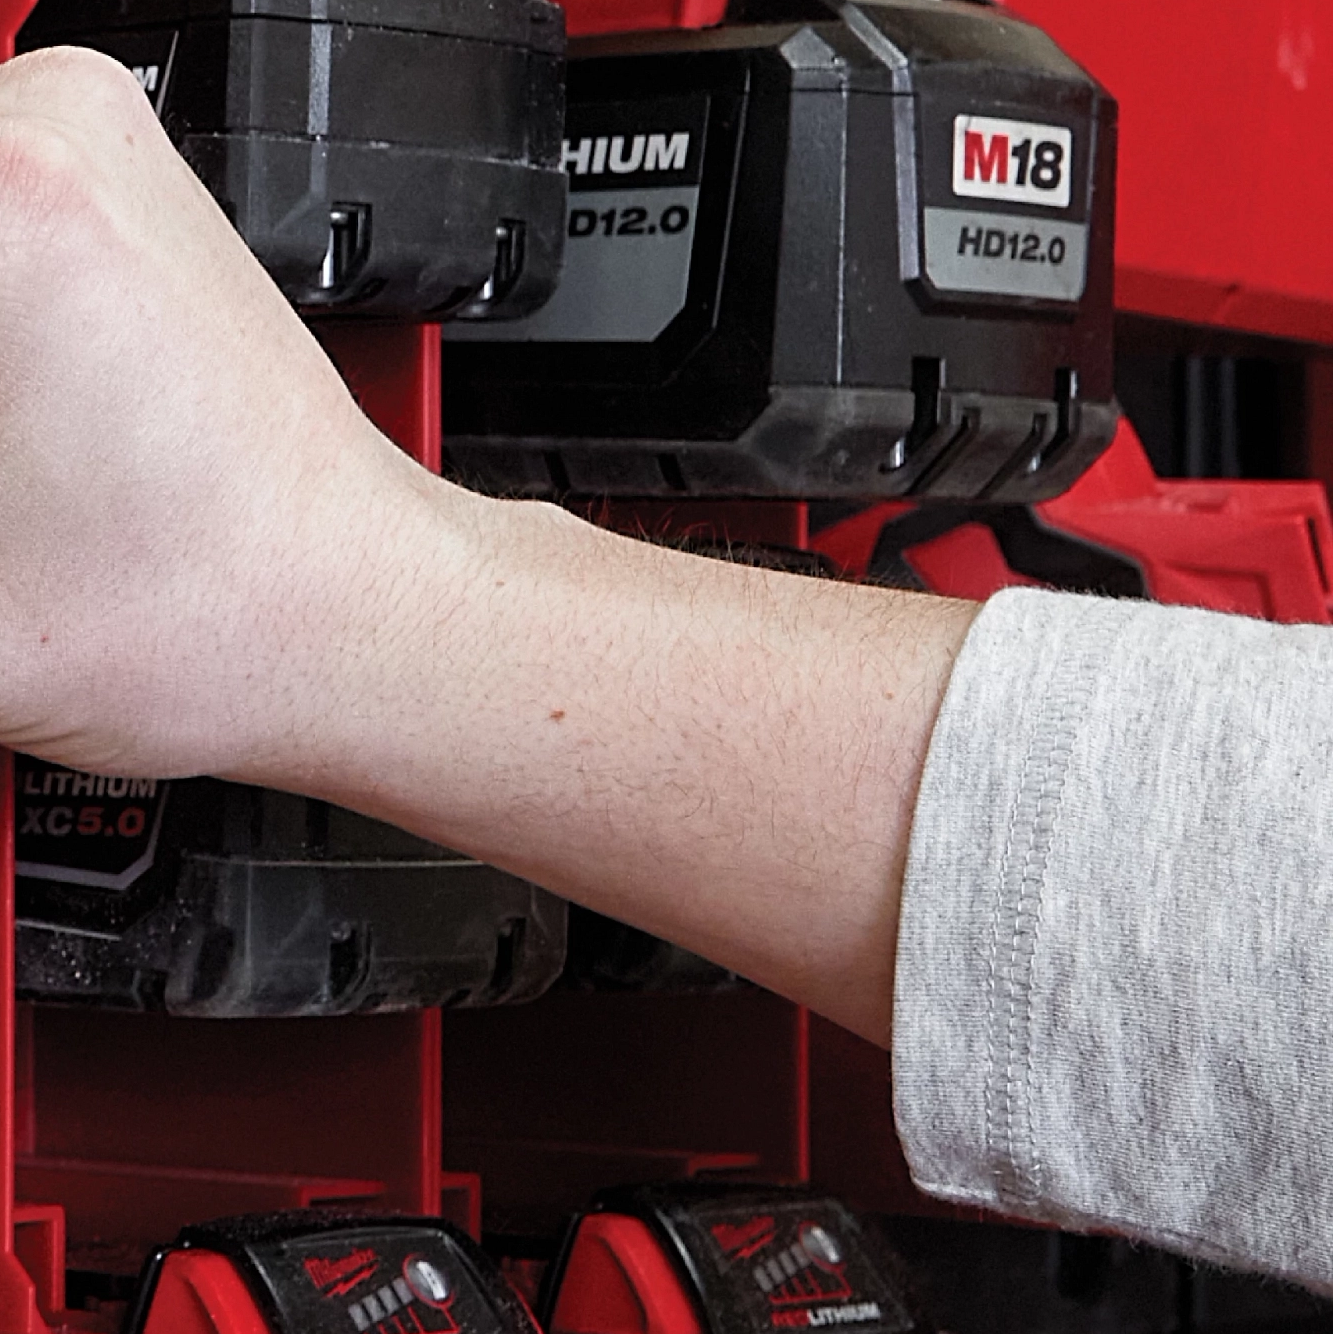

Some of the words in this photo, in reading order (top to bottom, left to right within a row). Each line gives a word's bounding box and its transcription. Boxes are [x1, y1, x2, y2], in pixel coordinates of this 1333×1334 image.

[964, 130, 1063, 190] M18
[568, 205, 690, 238] D12.0
[958, 226, 1065, 265] HD12.0
[19, 806, 146, 837] XC5.0
